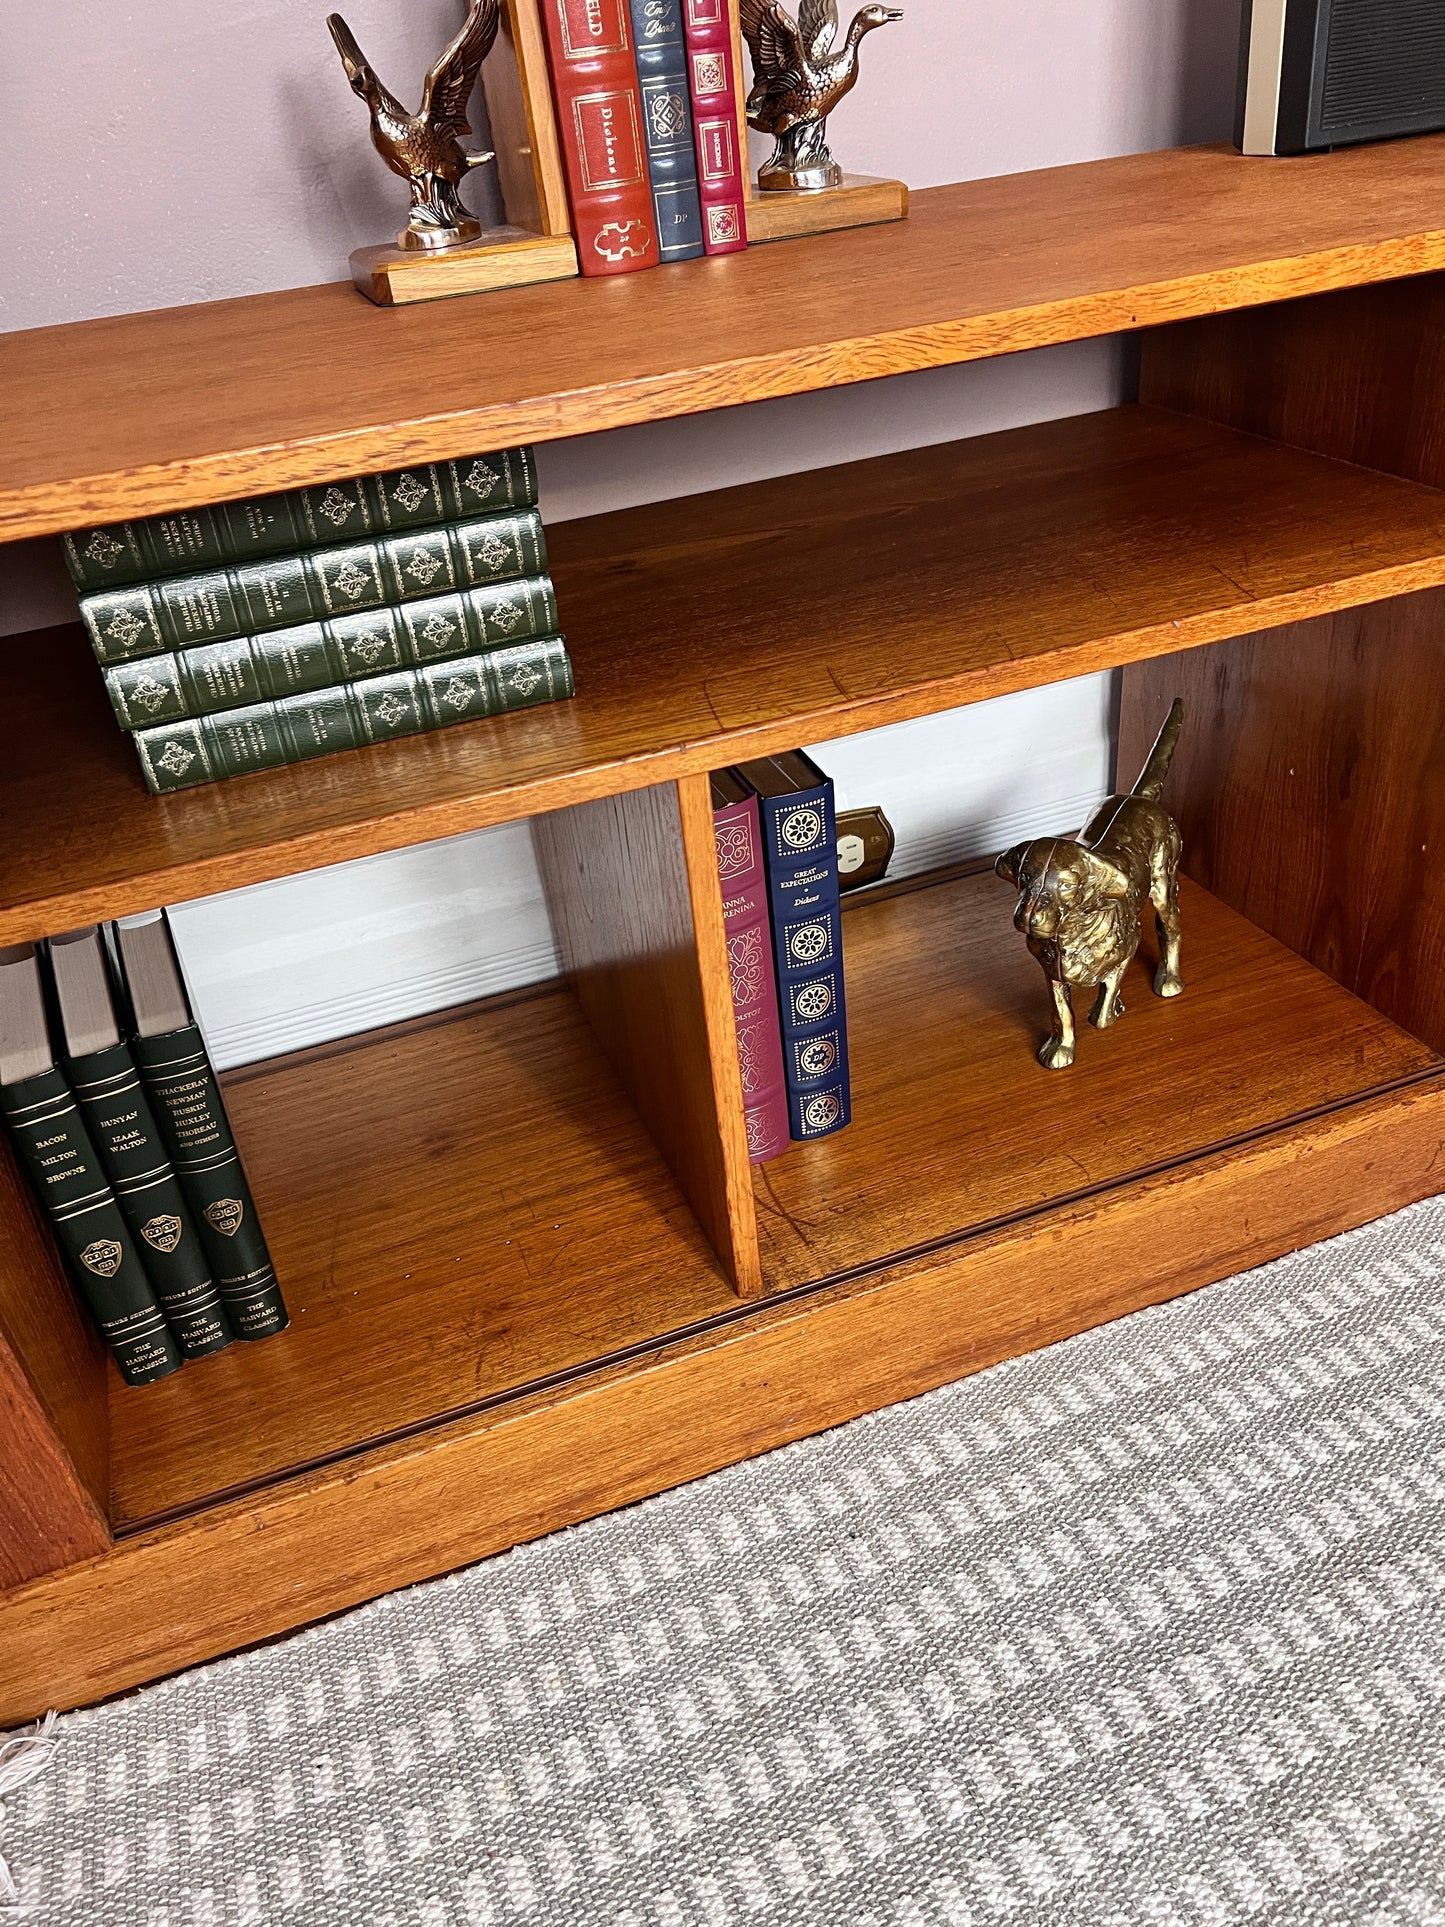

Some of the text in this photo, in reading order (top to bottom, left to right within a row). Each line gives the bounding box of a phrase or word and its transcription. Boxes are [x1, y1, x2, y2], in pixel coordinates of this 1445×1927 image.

[601, 107, 617, 174] Dickens
[674, 214, 688, 224] DP
[160, 521, 175, 557] CHARLES
[169, 520, 185, 556] DICKENS
[192, 519, 204, 548] WORKS
[178, 595, 194, 632] CHARLES
[186, 594, 203, 630] DICKENS
[203, 662, 218, 698] CHARLES
[211, 661, 226, 696] DICKENS
[780, 869, 829, 889] EXPECTATIONS
[793, 867, 817, 879] GREAT
[723, 901, 755, 918] RENINA
[735, 1007, 761, 1022] OLSTOY
[813, 1053, 825, 1062] DP
[155, 1076, 209, 1096] THACKERAY
[166, 1089, 206, 1107] NEWMAN
[172, 1101, 207, 1117] RUSKIN
[100, 1110, 139, 1128] BUNYAN
[175, 1111, 211, 1128] HUXLEY
[112, 1129, 140, 1144] IZAAK
[176, 1121, 217, 1138] THOREAU
[35, 1133, 68, 1149] BACON
[109, 1136, 147, 1153] WALTON
[179, 1132, 220, 1149] AND OTHERS
[40, 1149, 78, 1167] MILTON
[45, 1165, 87, 1184] BROWNE
[239, 1305, 277, 1323] HARVARD
[247, 1301, 265, 1312] THE
[181, 1321, 221, 1340] HARVARD
[189, 1317, 208, 1328] THE
[243, 1315, 280, 1331] CLASSICS
[133, 1342, 152, 1354] THE
[187, 1330, 223, 1348] CLASSICS
[125, 1346, 166, 1366] HARVARD
[130, 1355, 168, 1375] CLASSICS
